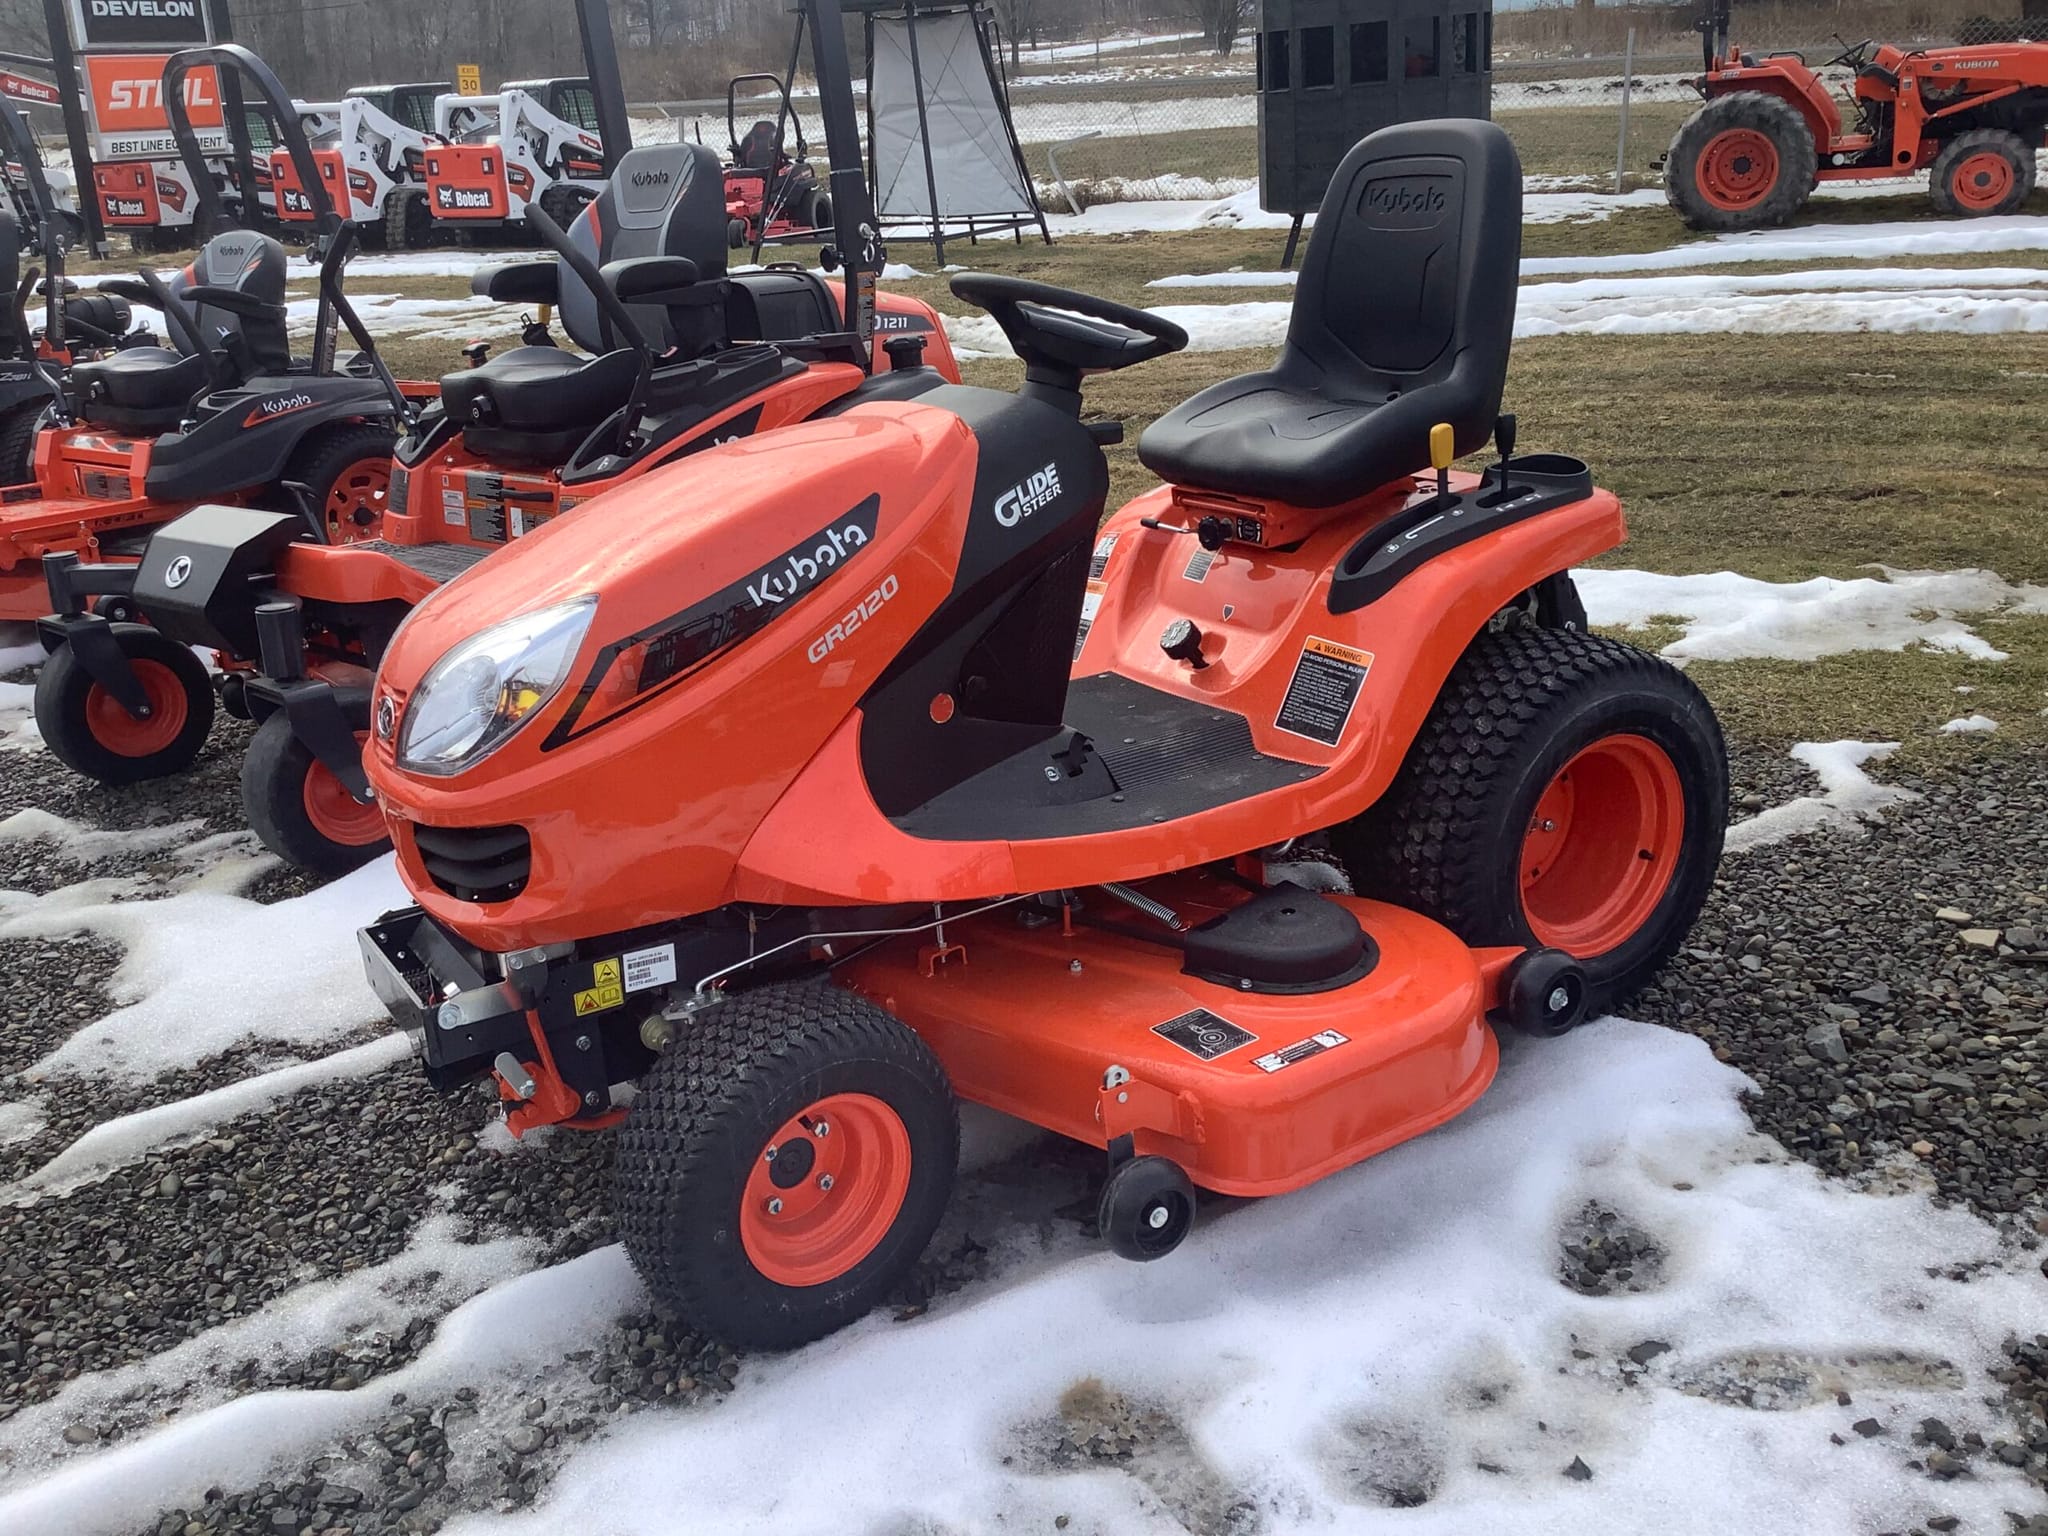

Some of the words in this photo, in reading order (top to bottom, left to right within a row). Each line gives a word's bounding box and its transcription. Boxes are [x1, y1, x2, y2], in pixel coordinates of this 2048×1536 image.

[91, 1, 195, 17] DEVELON
[1955, 60, 2000, 70] KUBOTA
[21, 84, 50, 99] Bobcat
[462, 79, 477, 91] 30
[111, 141, 139, 153] BEST
[140, 139, 163, 152] LINE
[631, 169, 669, 187] Kubota
[456, 191, 490, 207] Bobcat
[1368, 186, 1445, 214] Kubota
[118, 200, 145, 216] Bobcat
[219, 245, 244, 256] Kubota
[262, 393, 312, 413] Kubota
[994, 462, 1060, 527] GLIDE
[1022, 483, 1062, 517] STEER
[745, 523, 868, 608] Kubota
[806, 574, 900, 664] GR2120
[1324, 645, 1363, 663] WARNING
